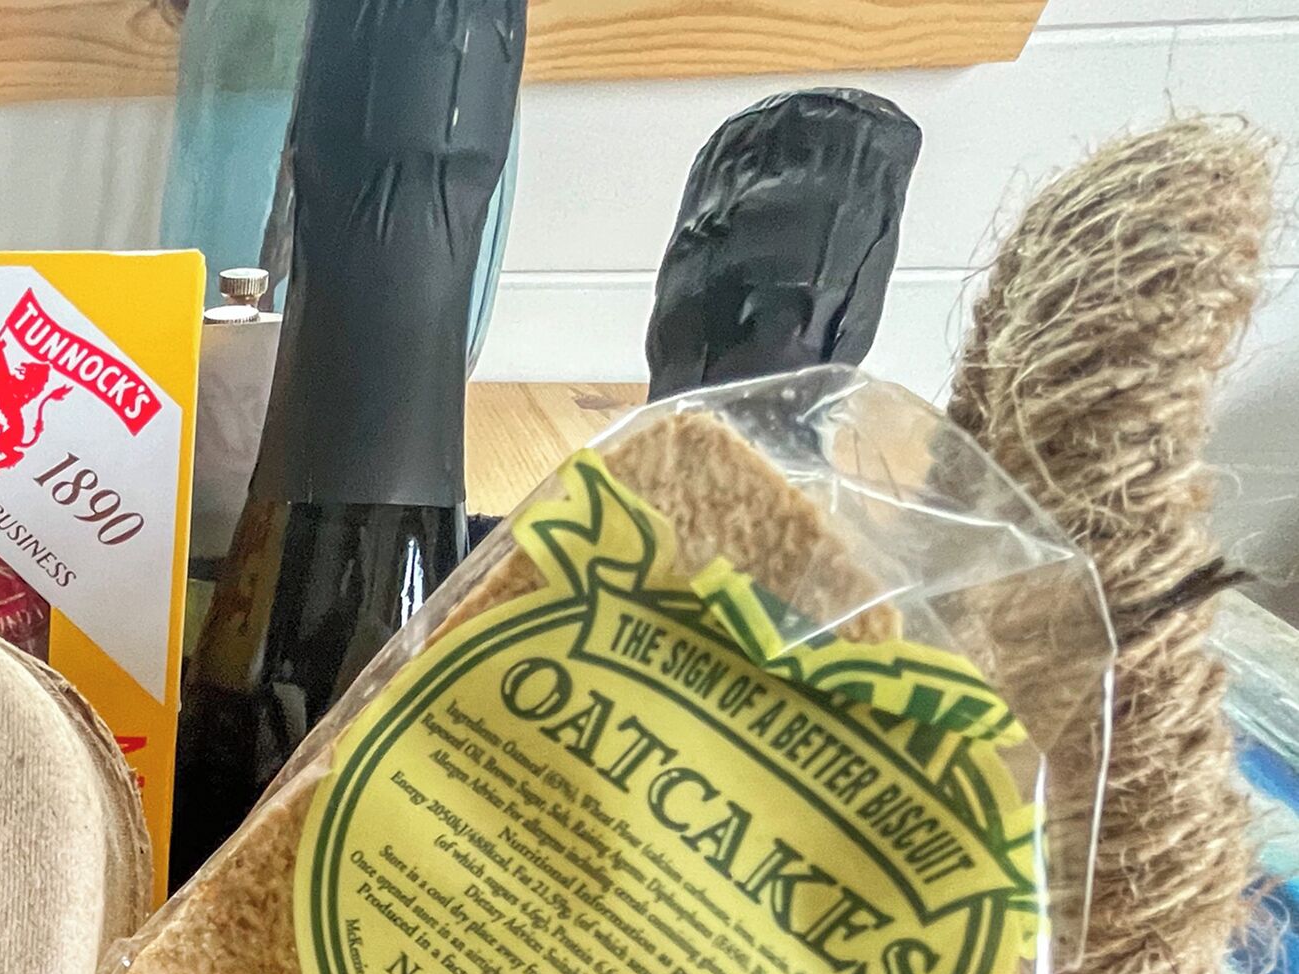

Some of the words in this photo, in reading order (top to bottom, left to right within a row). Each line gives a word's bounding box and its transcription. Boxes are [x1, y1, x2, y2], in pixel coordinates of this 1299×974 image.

[14, 302, 150, 420] TUNNOCK'S
[33, 453, 144, 546] 1890
[389, 769, 428, 805] Energy
[609, 613, 669, 667] THE
[664, 642, 728, 700] SIGN
[719, 679, 769, 719] OF
[751, 704, 782, 734] A
[771, 710, 877, 818] BETTER
[858, 773, 975, 886] BISCUIT
[349, 849, 377, 878] Once
[375, 874, 417, 908] opened
[411, 904, 439, 929] store
[436, 922, 451, 939] in
[449, 936, 465, 952] an
[378, 844, 407, 872] Store
[405, 866, 419, 882] in
[417, 880, 427, 889] a
[425, 887, 455, 908] cool
[449, 903, 469, 924] dry
[463, 920, 498, 946] place
[494, 943, 525, 969] away
[433, 833, 457, 852] (of
[451, 848, 485, 878] which
[482, 876, 519, 905] sugars
[463, 883, 506, 922] Dietary
[497, 825, 578, 889] Nutritional
[572, 882, 656, 954] Information
[355, 881, 420, 938] Produced
[414, 931, 431, 950] in
[430, 948, 440, 959] a
